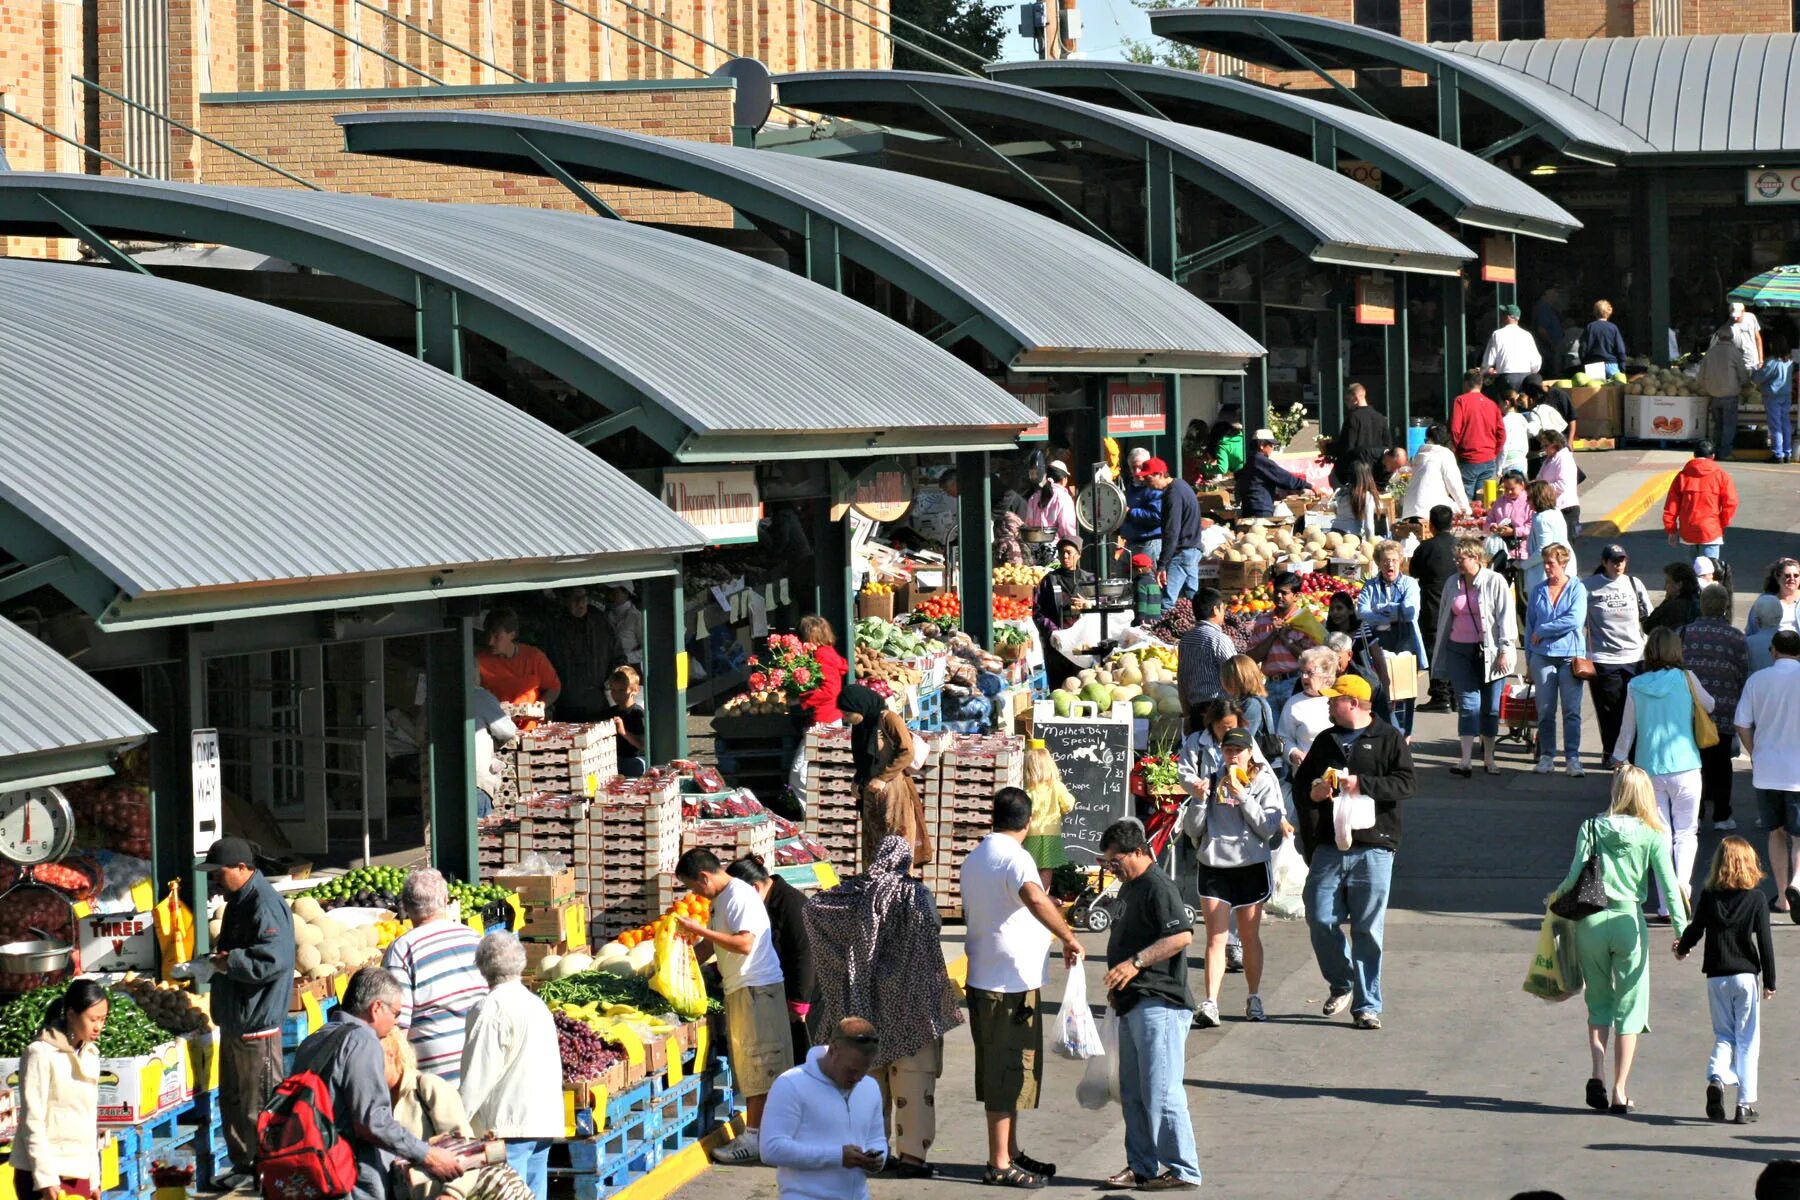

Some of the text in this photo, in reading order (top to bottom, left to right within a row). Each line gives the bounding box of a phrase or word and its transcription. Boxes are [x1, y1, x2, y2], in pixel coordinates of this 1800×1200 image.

[197, 742, 216, 768] ONE
[198, 776, 216, 802] WAY
[0, 828, 6, 836] 3
[42, 841, 47, 849] 6
[90, 921, 144, 937] THREE
[112, 940, 123, 957] V
